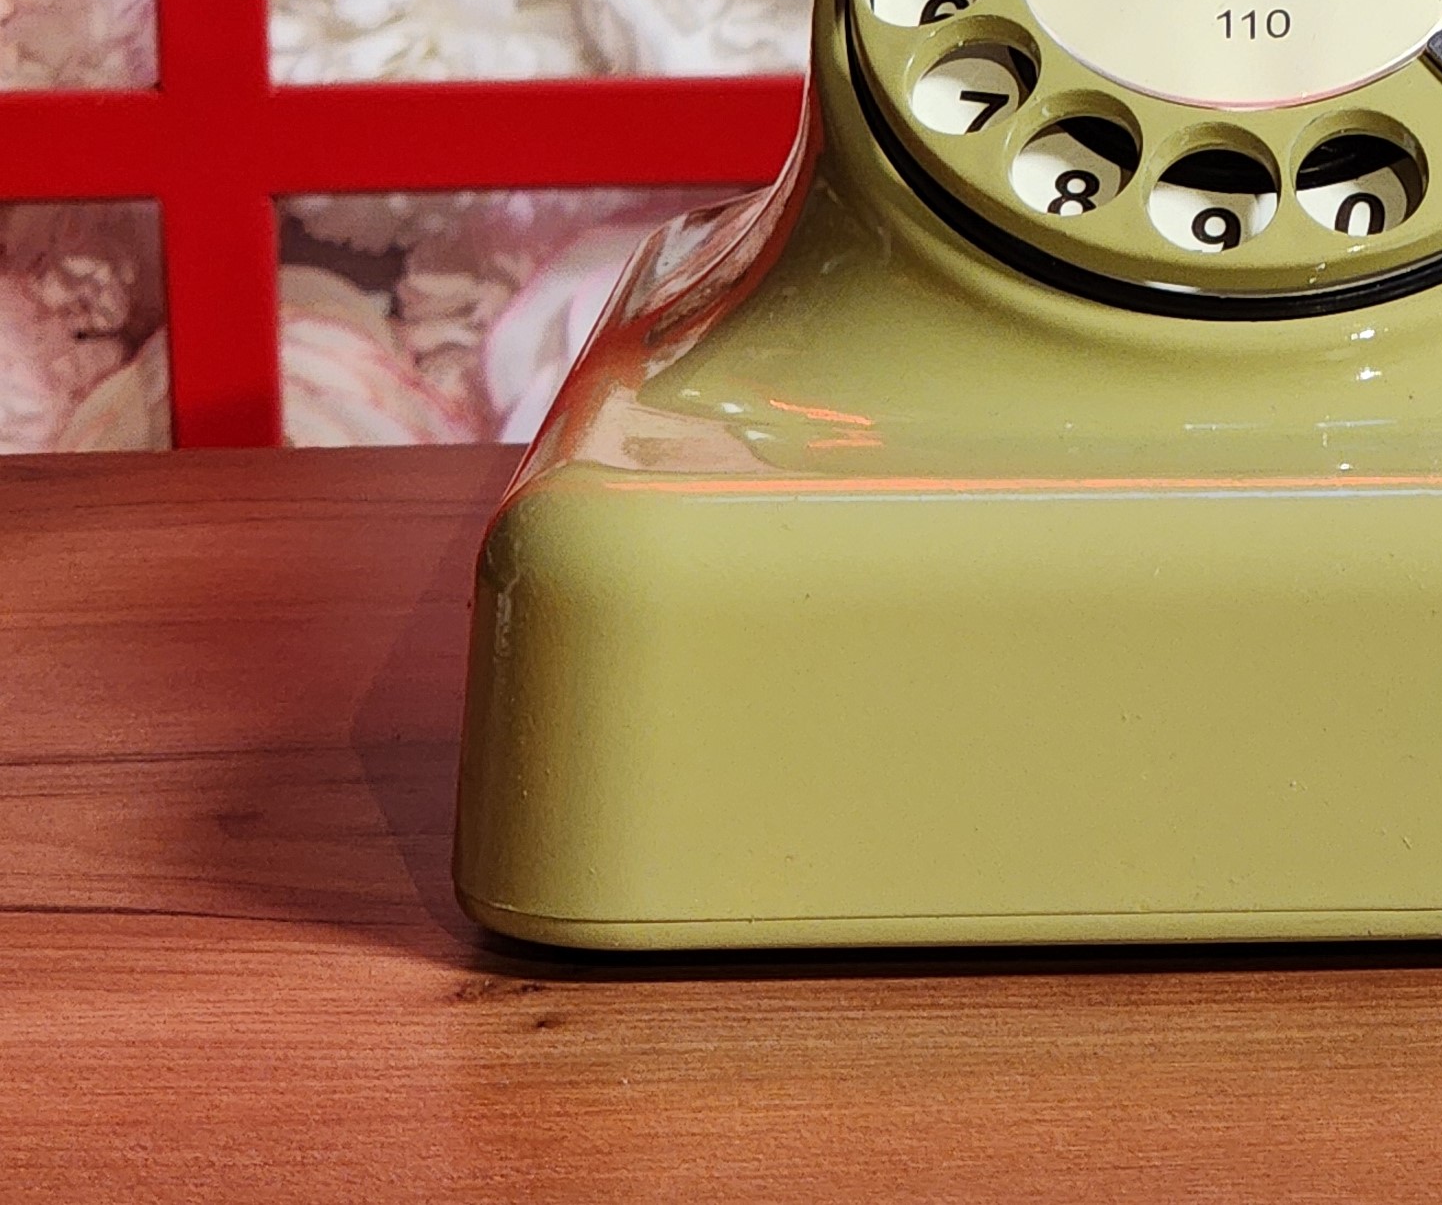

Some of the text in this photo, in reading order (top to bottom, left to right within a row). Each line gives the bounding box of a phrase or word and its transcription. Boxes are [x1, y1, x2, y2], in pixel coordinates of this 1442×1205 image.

[1217, 9, 1291, 40] 110
[959, 90, 1010, 134] 7
[1047, 169, 1101, 216] 8
[1191, 207, 1242, 252] 9
